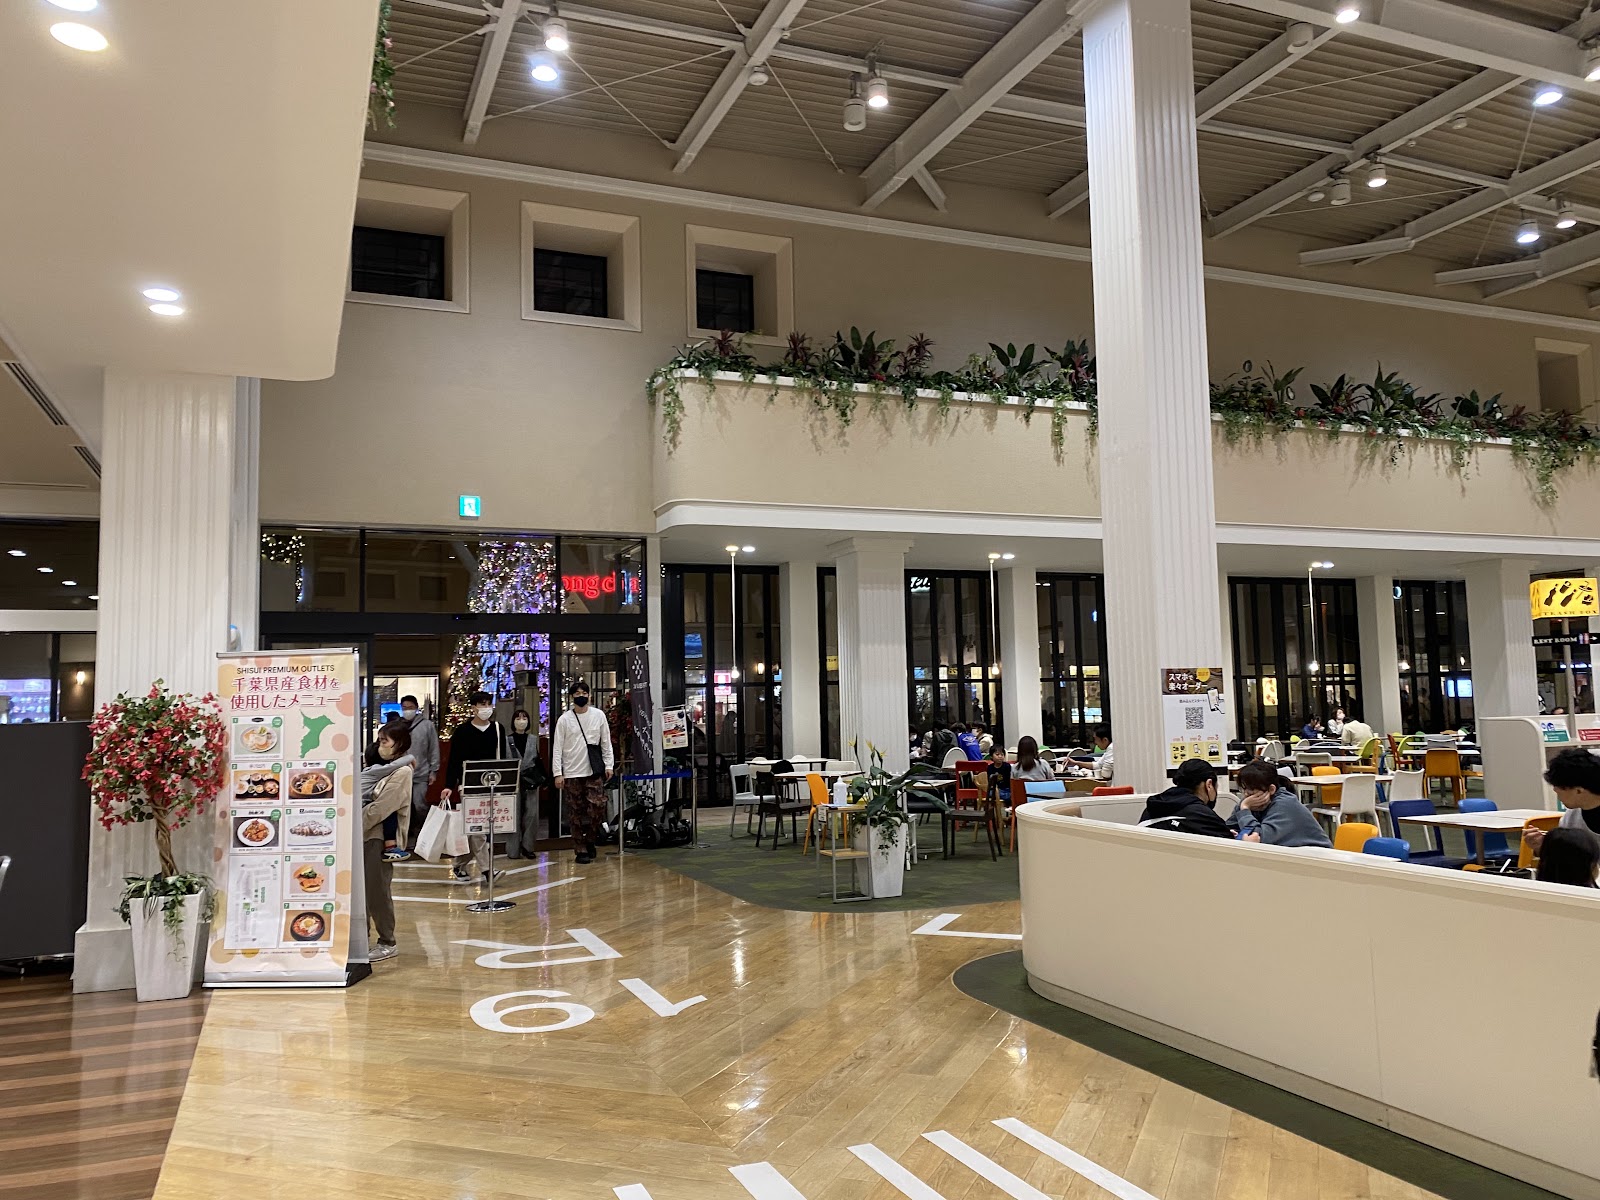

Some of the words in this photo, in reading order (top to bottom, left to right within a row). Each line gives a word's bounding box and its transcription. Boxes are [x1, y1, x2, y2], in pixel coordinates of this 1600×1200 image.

[1554, 636, 1578, 644] ROOM
[236, 667, 262, 675] SHISUI
[262, 665, 299, 674] PREMIUM
[300, 664, 335, 673] OUTLETS
[232, 675, 340, 692] 千葉県産食材を
[230, 694, 341, 710] 使用したメニュー
